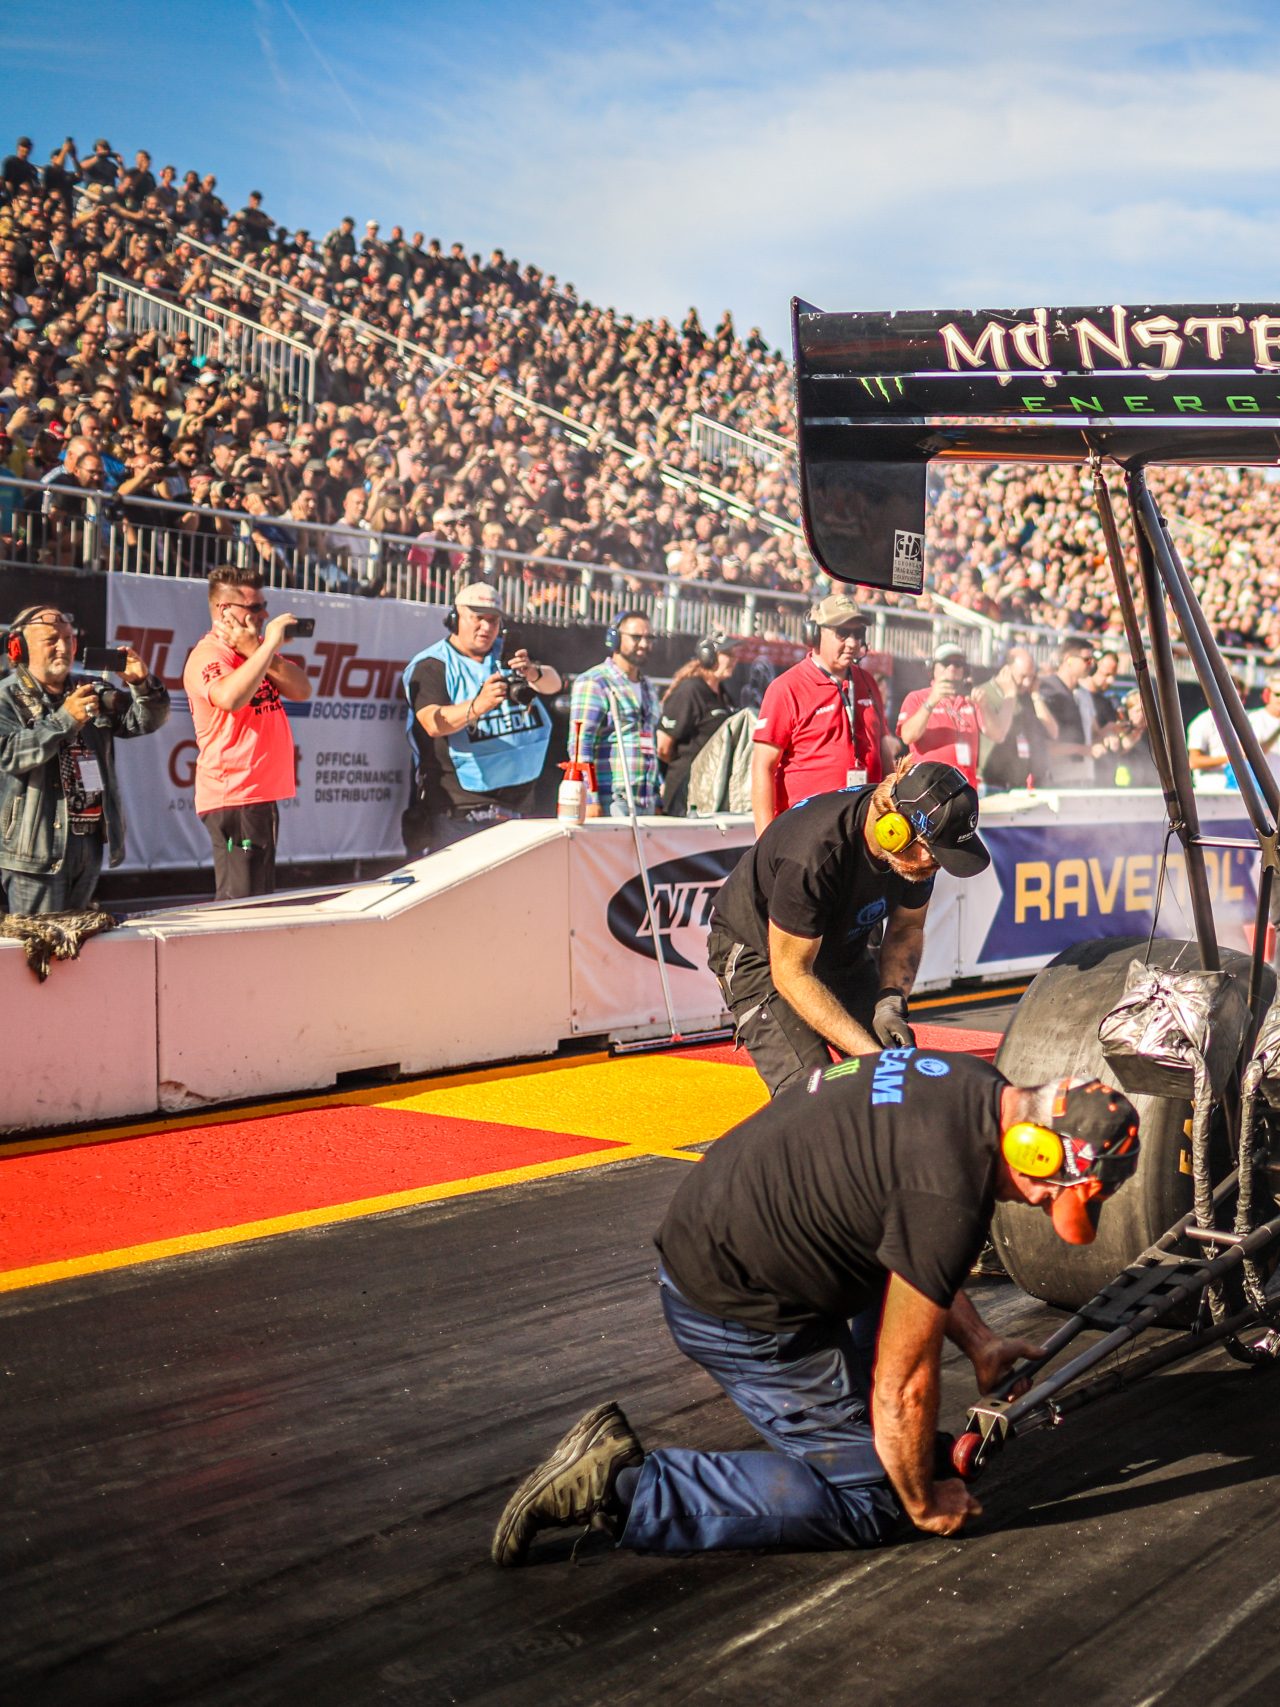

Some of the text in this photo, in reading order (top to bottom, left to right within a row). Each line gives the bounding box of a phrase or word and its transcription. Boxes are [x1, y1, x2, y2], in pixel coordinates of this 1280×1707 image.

[312, 701, 377, 720] BOOSTED
[378, 704, 398, 721] BY
[315, 751, 370, 767] OFFICIAL
[315, 768, 403, 785] PERFORMANCE
[315, 786, 392, 804] DISTRIBUTOR
[1014, 850, 1245, 924] RAVENOL
[872, 1047, 916, 1105] EAM
